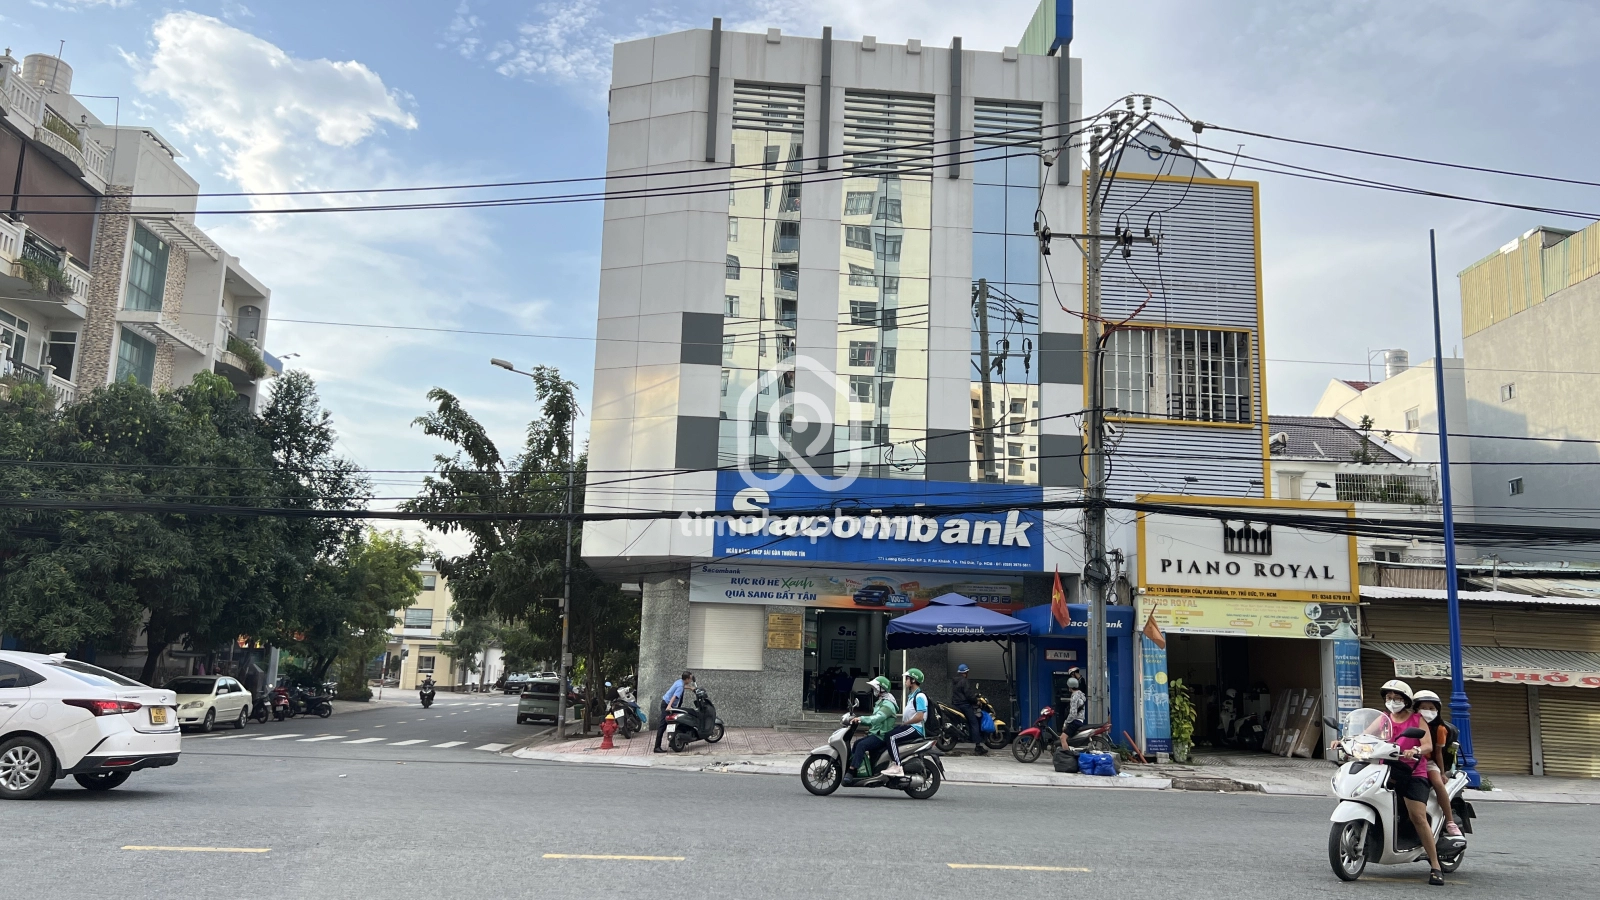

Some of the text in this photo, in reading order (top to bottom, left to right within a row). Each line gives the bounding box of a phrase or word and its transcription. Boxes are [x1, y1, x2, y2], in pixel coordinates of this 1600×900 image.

[728, 488, 1033, 547] Sacombank
[702, 565, 741, 574] Sacombank
[1161, 558, 1335, 580] PIANO ROYAL
[730, 576, 815, 589] RỰC RỠ HÈ Xanh
[725, 589, 817, 602] QUÀ SANG BẤT TẬN
[1143, 598, 1198, 607] PIANO ROYAL
[936, 625, 985, 634] Sacombank
[1066, 618, 1122, 629] acoank
[1489, 671, 1570, 683] PHỞ
